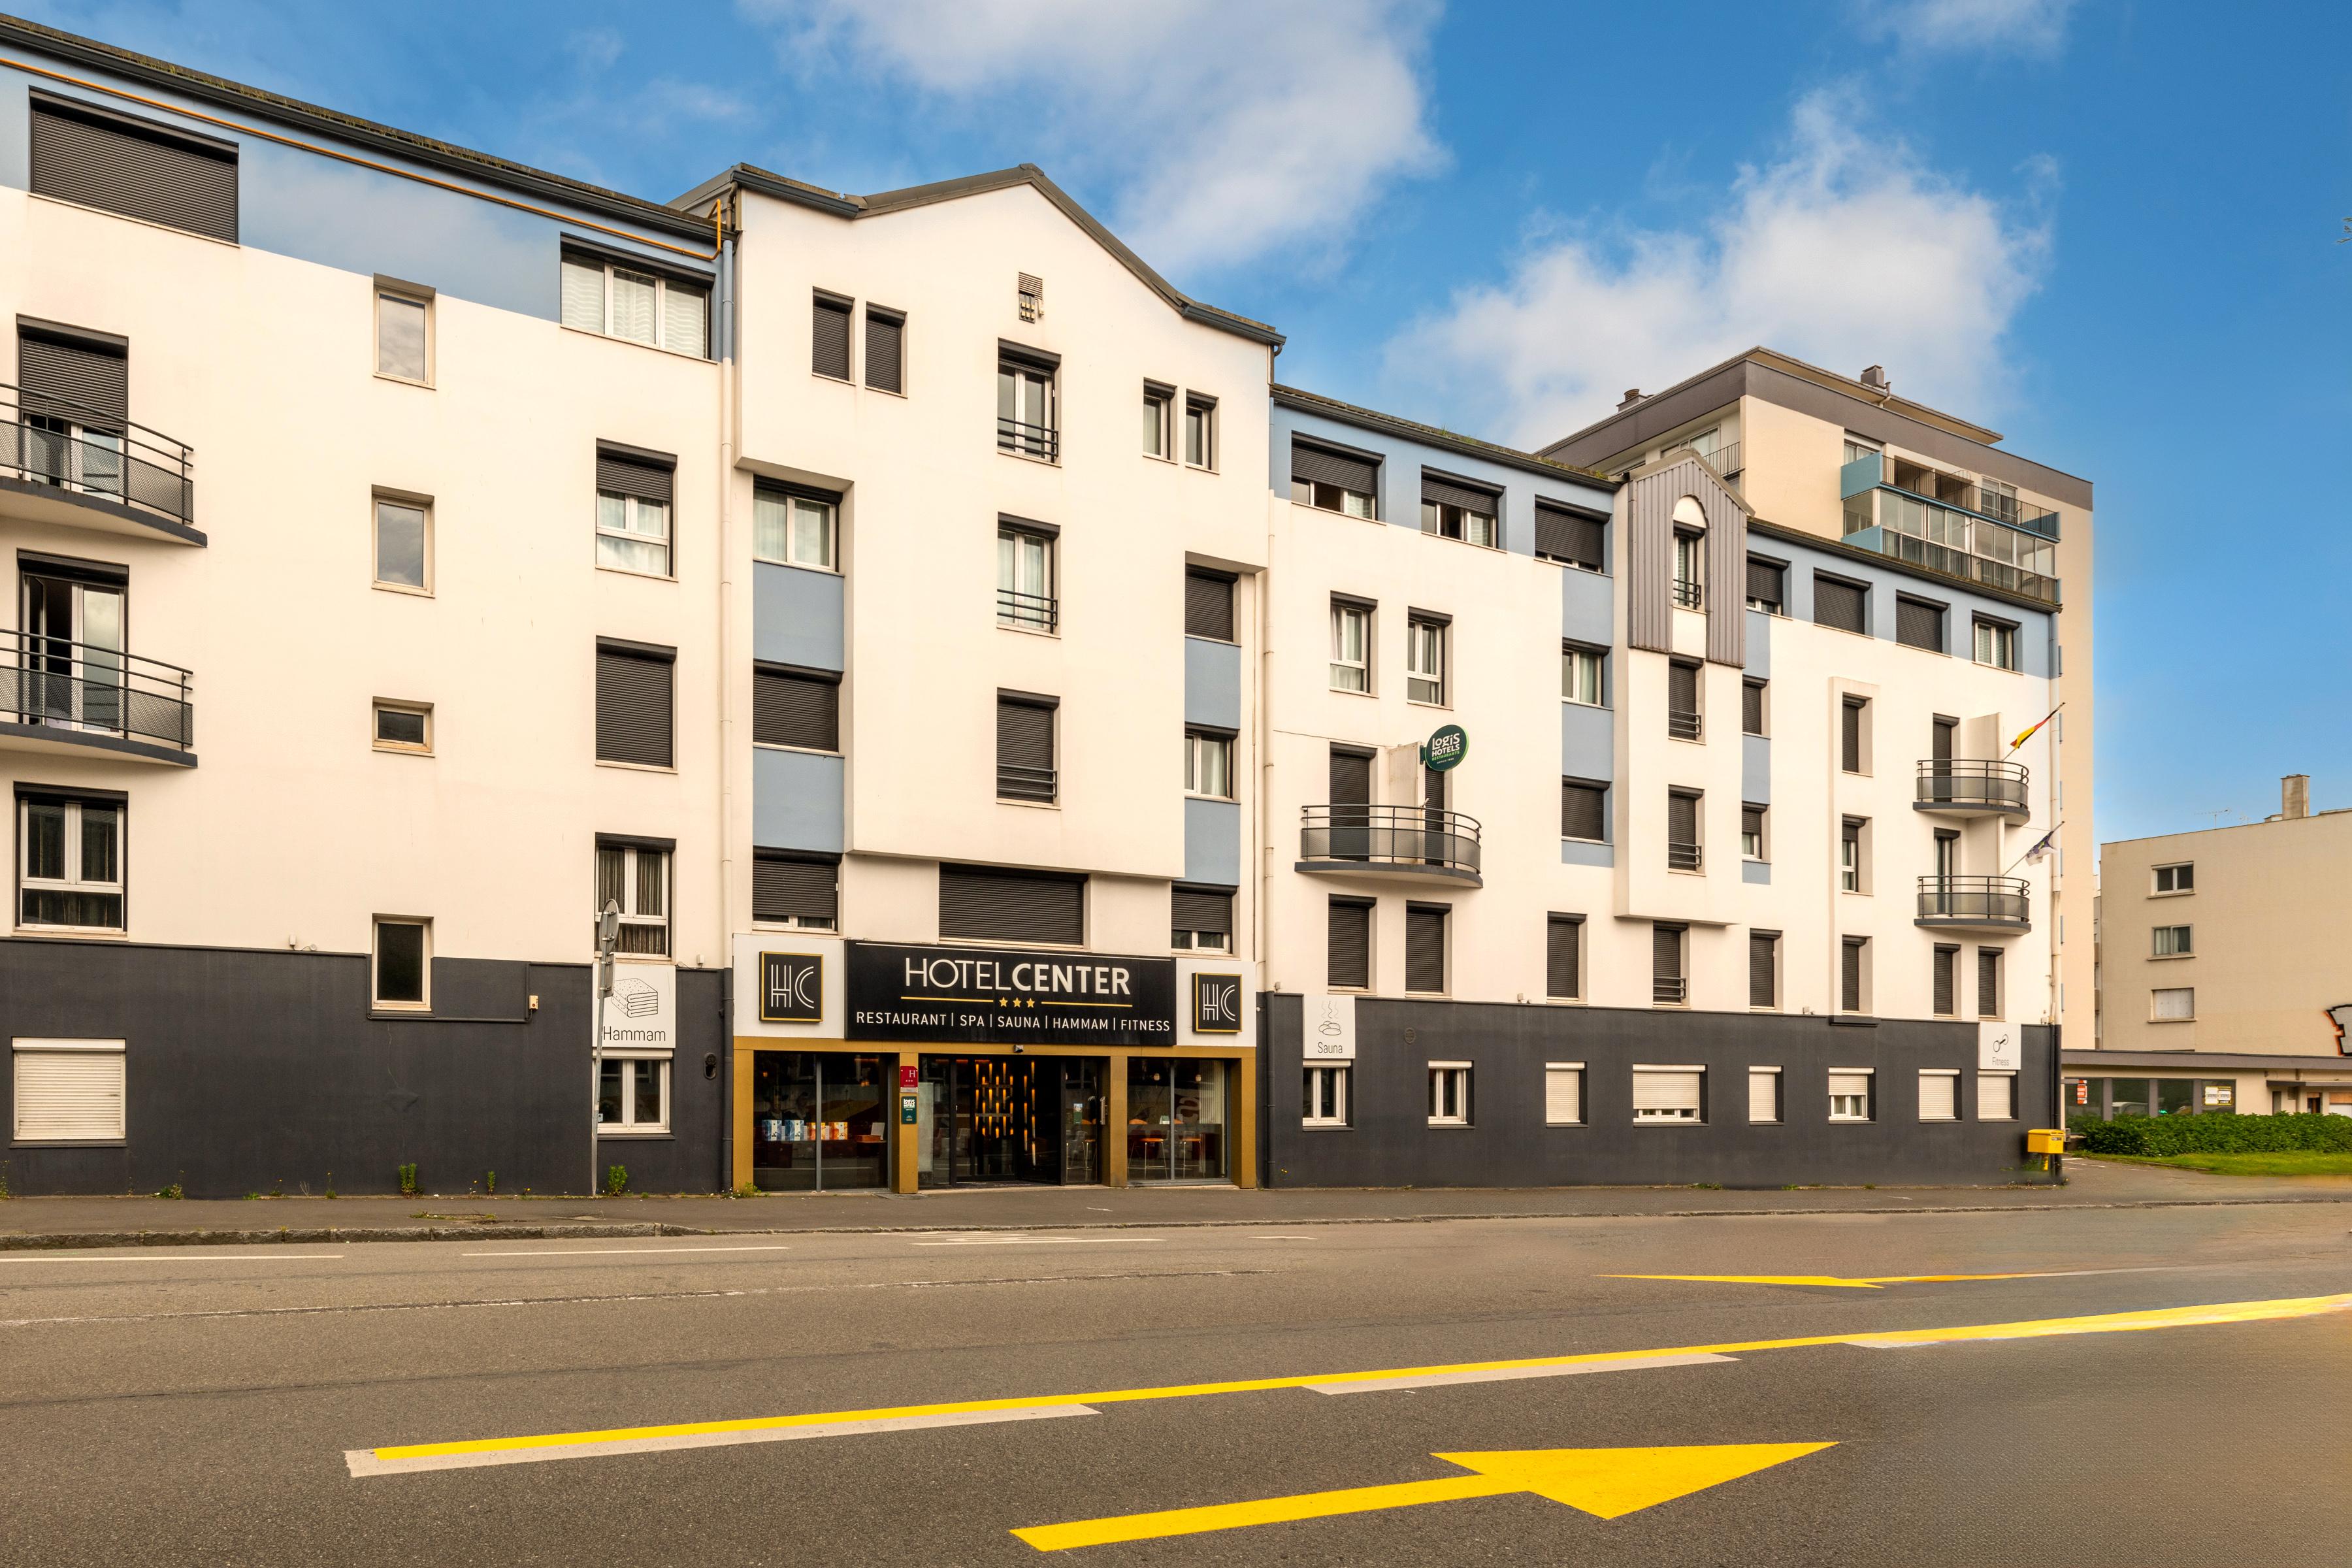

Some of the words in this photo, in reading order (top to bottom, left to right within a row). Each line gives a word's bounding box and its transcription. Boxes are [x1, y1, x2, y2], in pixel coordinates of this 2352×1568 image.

[1431, 744, 1460, 757] HOTELS
[1431, 751, 1460, 761] RESTAURANTS
[771, 964, 815, 1009] HC
[1203, 983, 1235, 1021] HC
[857, 1011, 947, 1026] RESTAURANT
[960, 1015, 985, 1027] SPA
[998, 1016, 1040, 1028] SAUNA
[1053, 1017, 1108, 1030] HAMMAM
[1120, 1019, 1170, 1032] FITNESS
[603, 1026, 666, 1041] Hammam
[1317, 1041, 1343, 1054] Sauna
[909, 1070, 916, 1078] H
